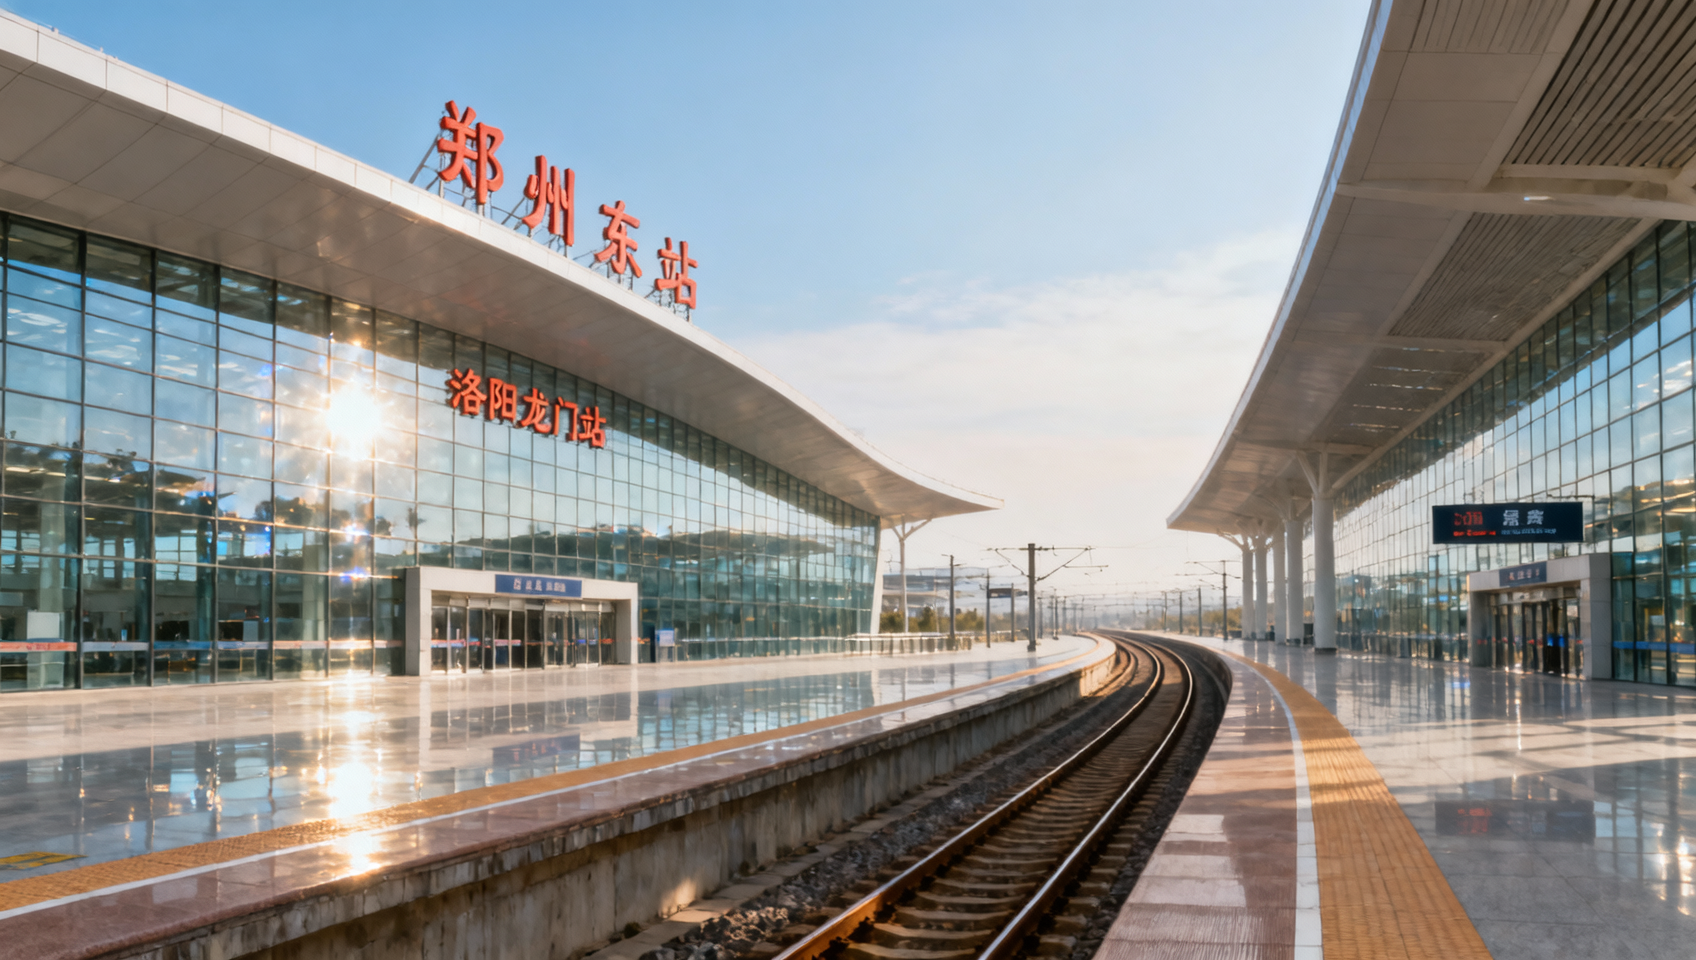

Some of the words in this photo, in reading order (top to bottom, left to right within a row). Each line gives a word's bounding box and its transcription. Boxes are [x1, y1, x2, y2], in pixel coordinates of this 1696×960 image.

[437, 100, 698, 310] 郑州东站
[448, 367, 607, 449] 洛阳龙门站
